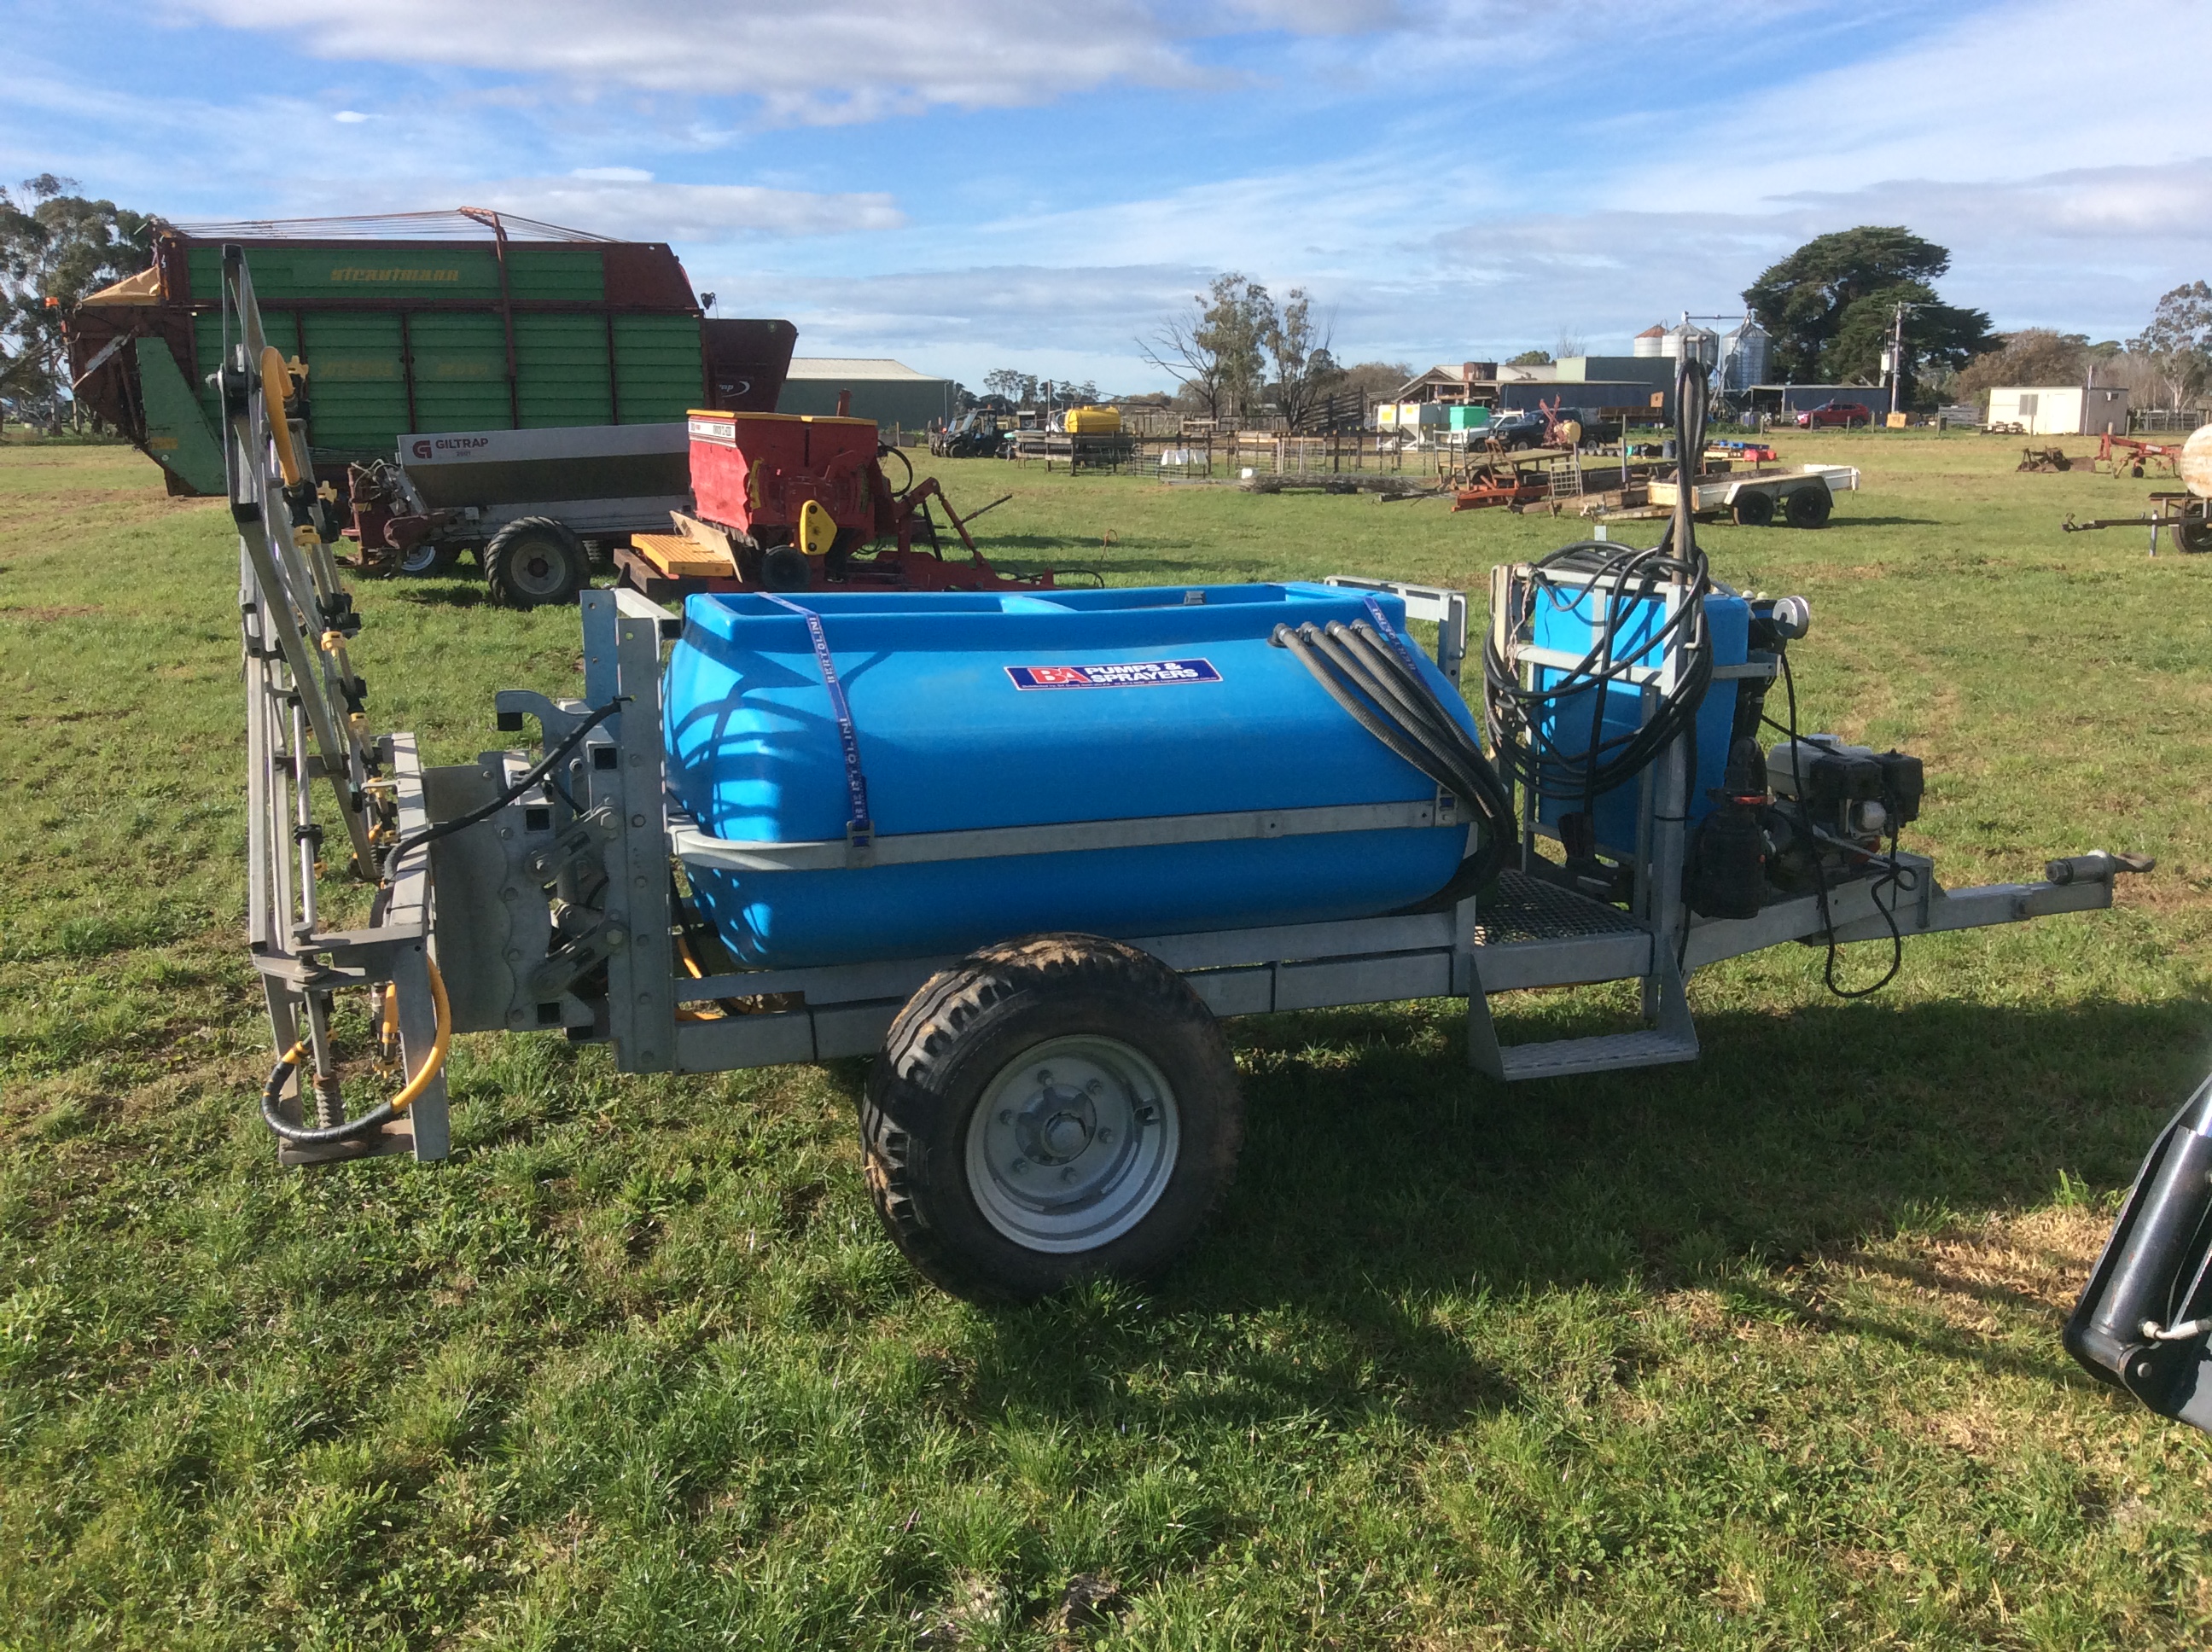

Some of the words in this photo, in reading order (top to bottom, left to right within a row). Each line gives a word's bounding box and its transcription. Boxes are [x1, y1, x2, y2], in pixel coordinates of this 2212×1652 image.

[435, 438, 489, 449] GILTRAP
[808, 617, 835, 683] BERTOLINI
[1027, 667, 1091, 683] BA
[1085, 664, 1161, 676] PUMPS
[1166, 662, 1184, 672] &
[1090, 668, 1199, 683] SPRAYERS
[839, 718, 864, 819] BERTOLINI
